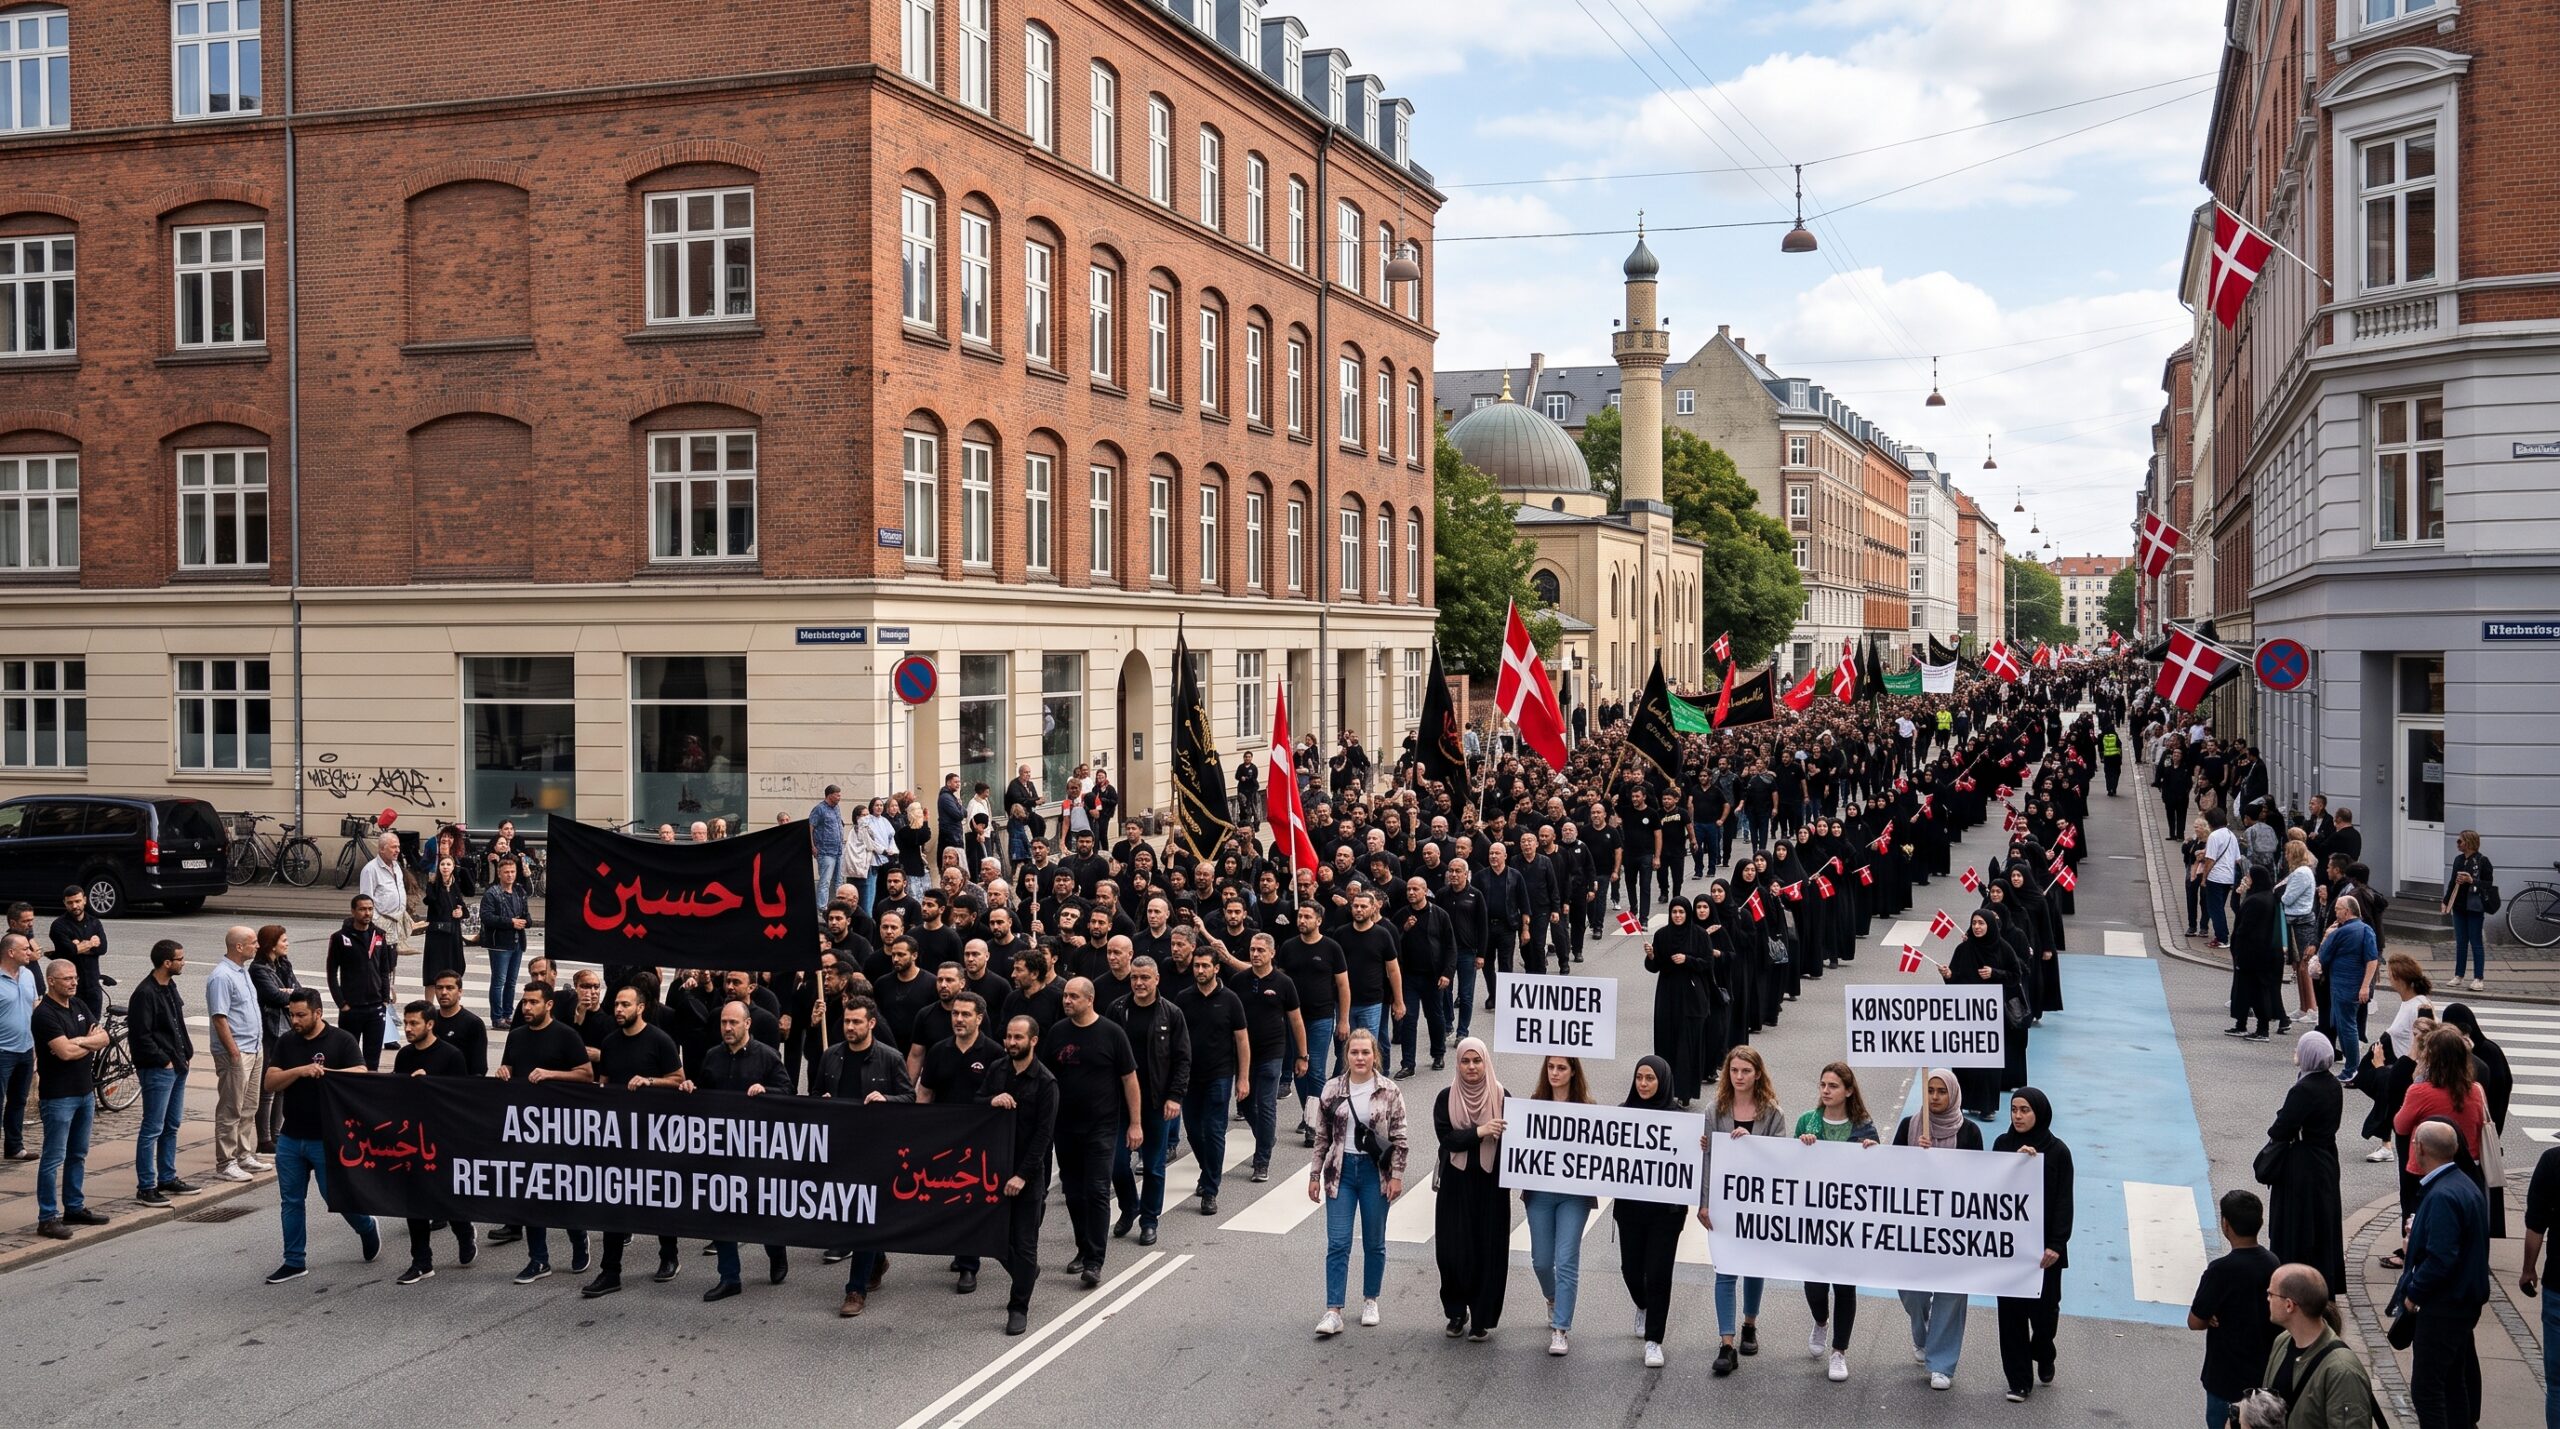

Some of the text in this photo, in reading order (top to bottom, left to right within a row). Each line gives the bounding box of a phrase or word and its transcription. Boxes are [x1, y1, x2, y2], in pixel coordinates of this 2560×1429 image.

[583, 853, 788, 940] يا حسين
[1510, 982, 1602, 1014] KVINDER
[1851, 997, 1998, 1022] KØNSOPDELING
[1515, 1017, 1594, 1047] ER LIGE
[1851, 1030, 2000, 1054] ER IKKE LIGHED
[502, 1105, 829, 1163] ASHURA I KØBENHAVN
[1526, 1113, 1678, 1156] INDDRAGELSE,
[1507, 1147, 1694, 1190] IKKE SEPARATION
[453, 1157, 877, 1225] RETFÆRDIGHED FOR HUSAYN
[1723, 1174, 2030, 1222] FOR ET LIGESTILLET DANSK
[1735, 1211, 2015, 1258] MUSLIMSK FÆLLESSKAB
